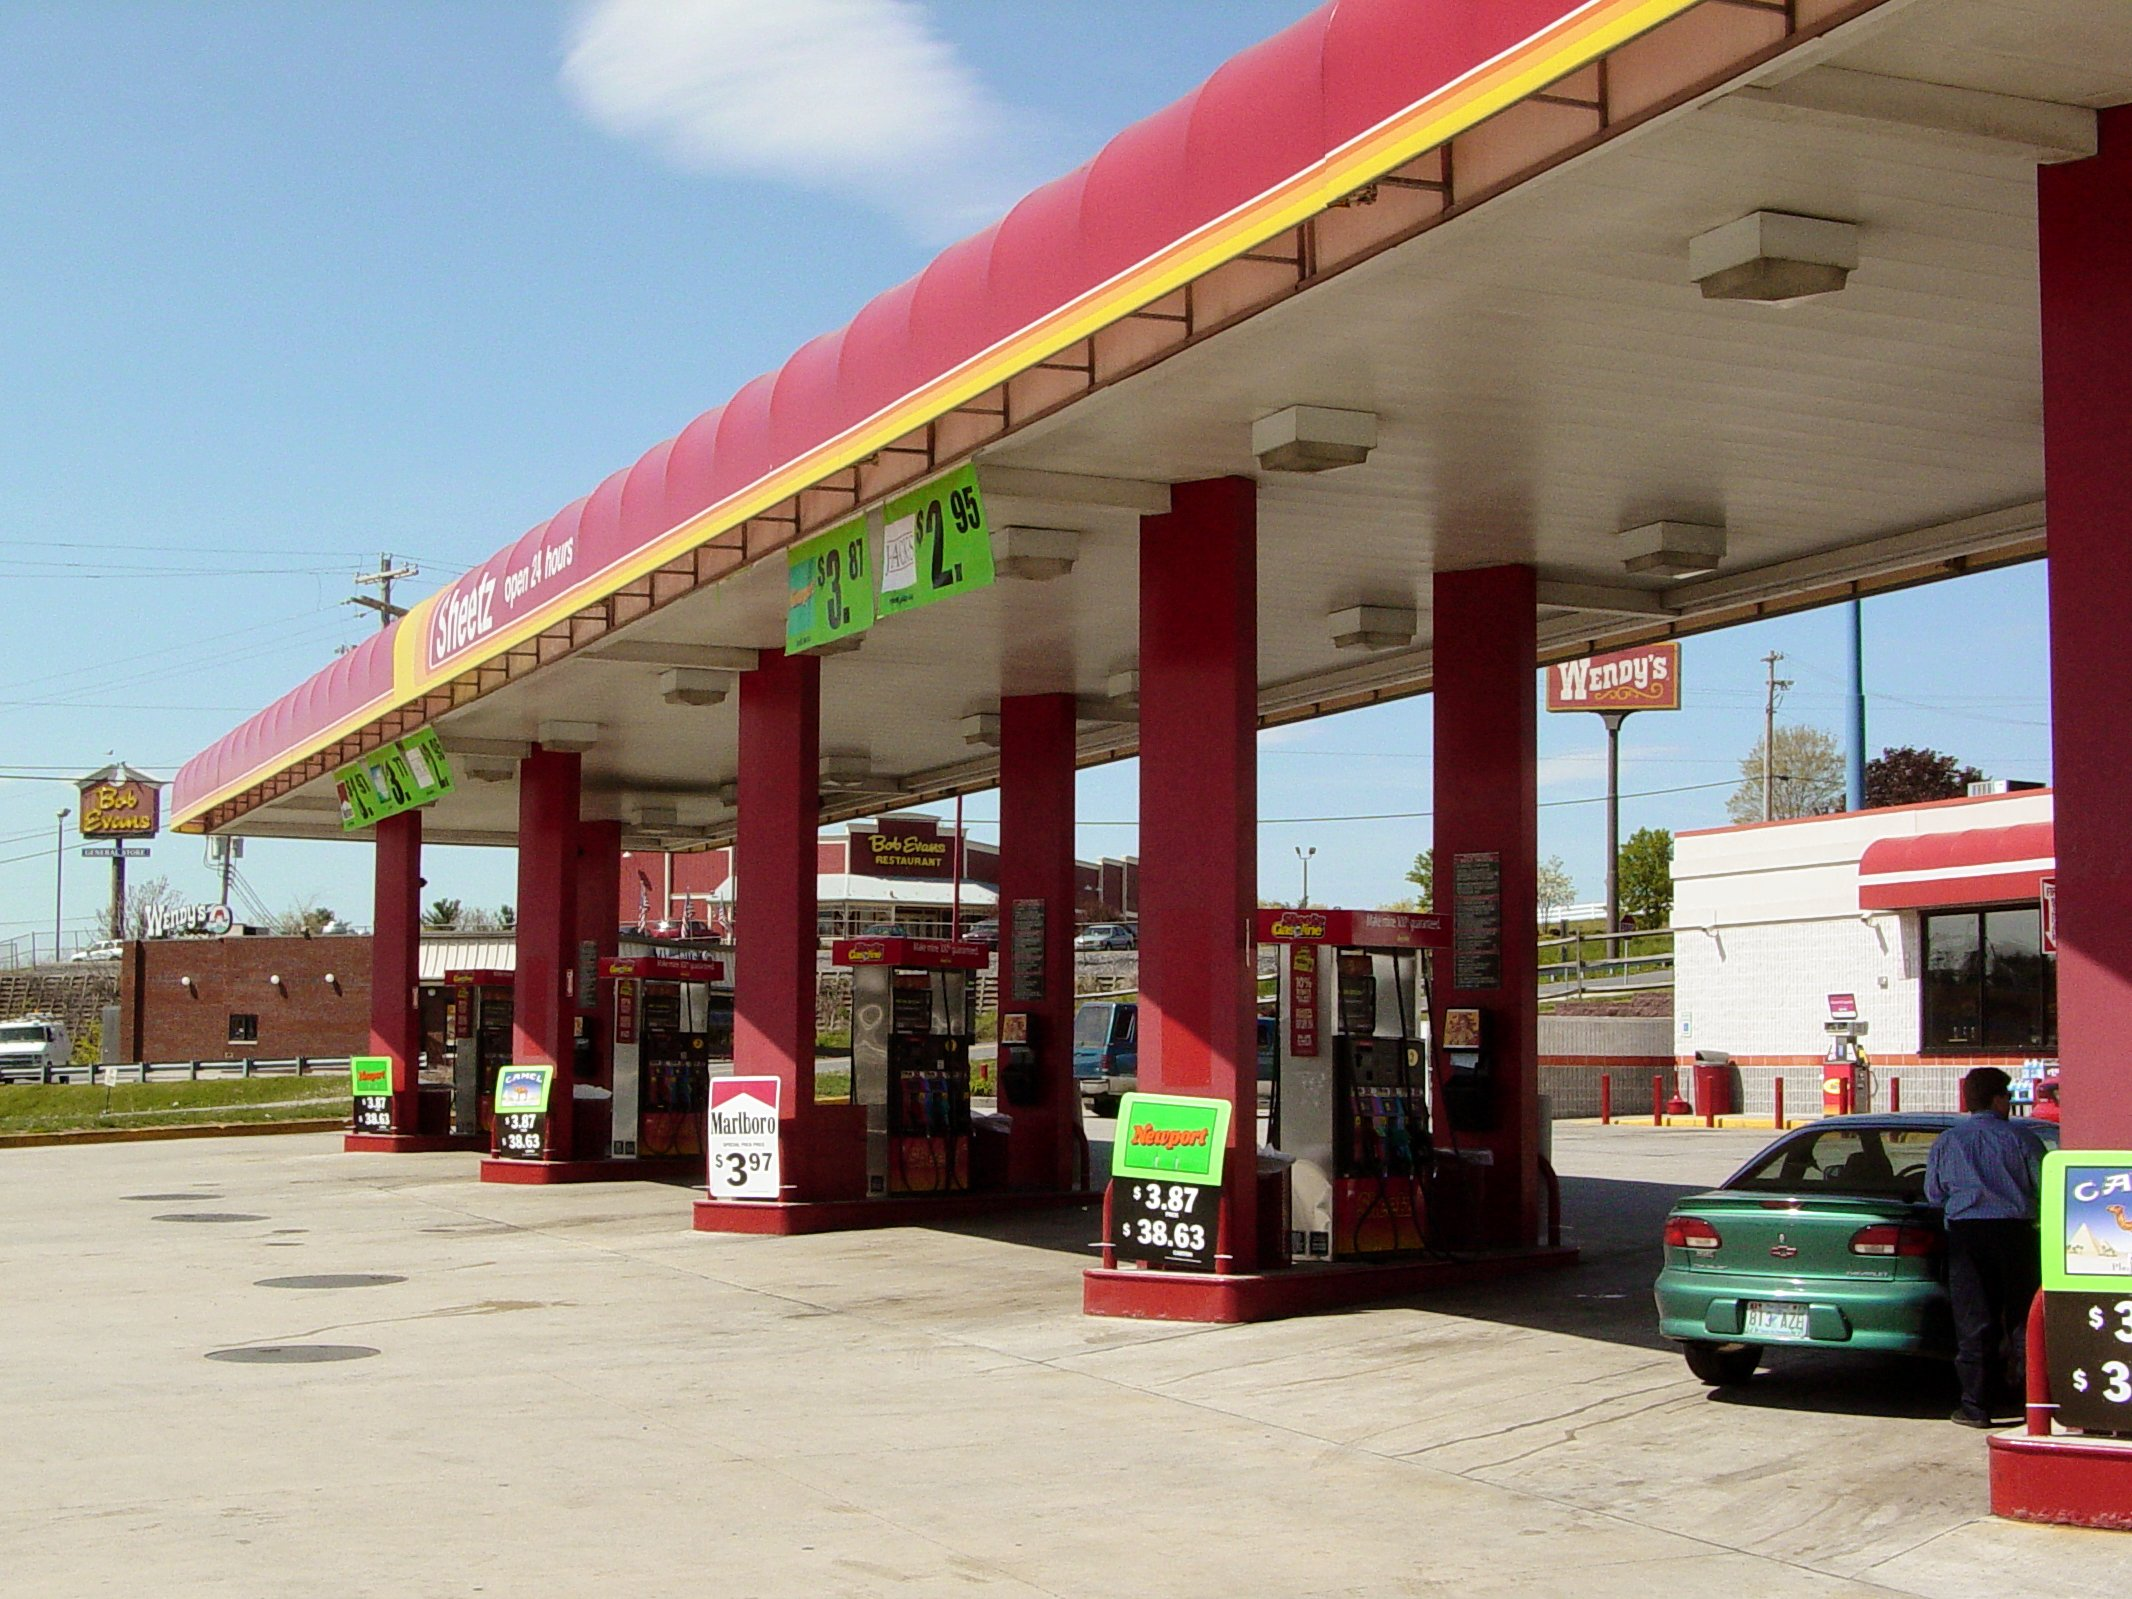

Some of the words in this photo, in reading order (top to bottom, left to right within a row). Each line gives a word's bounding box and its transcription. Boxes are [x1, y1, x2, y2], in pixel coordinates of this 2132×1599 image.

[503, 566, 530, 609] open
[530, 549, 543, 588] 24
[544, 536, 574, 580] hours
[436, 572, 497, 659] Sheetz
[1557, 653, 1669, 701] Wendy's
[95, 785, 139, 809] Bob
[83, 809, 152, 832] Evans
[867, 834, 902, 852] Bob
[902, 836, 947, 854] Evans
[875, 855, 942, 867] RESTAURANT
[505, 1072, 543, 1084] CAMEL
[710, 1111, 776, 1135] Marlboro
[1130, 1122, 1209, 1151] Newport
